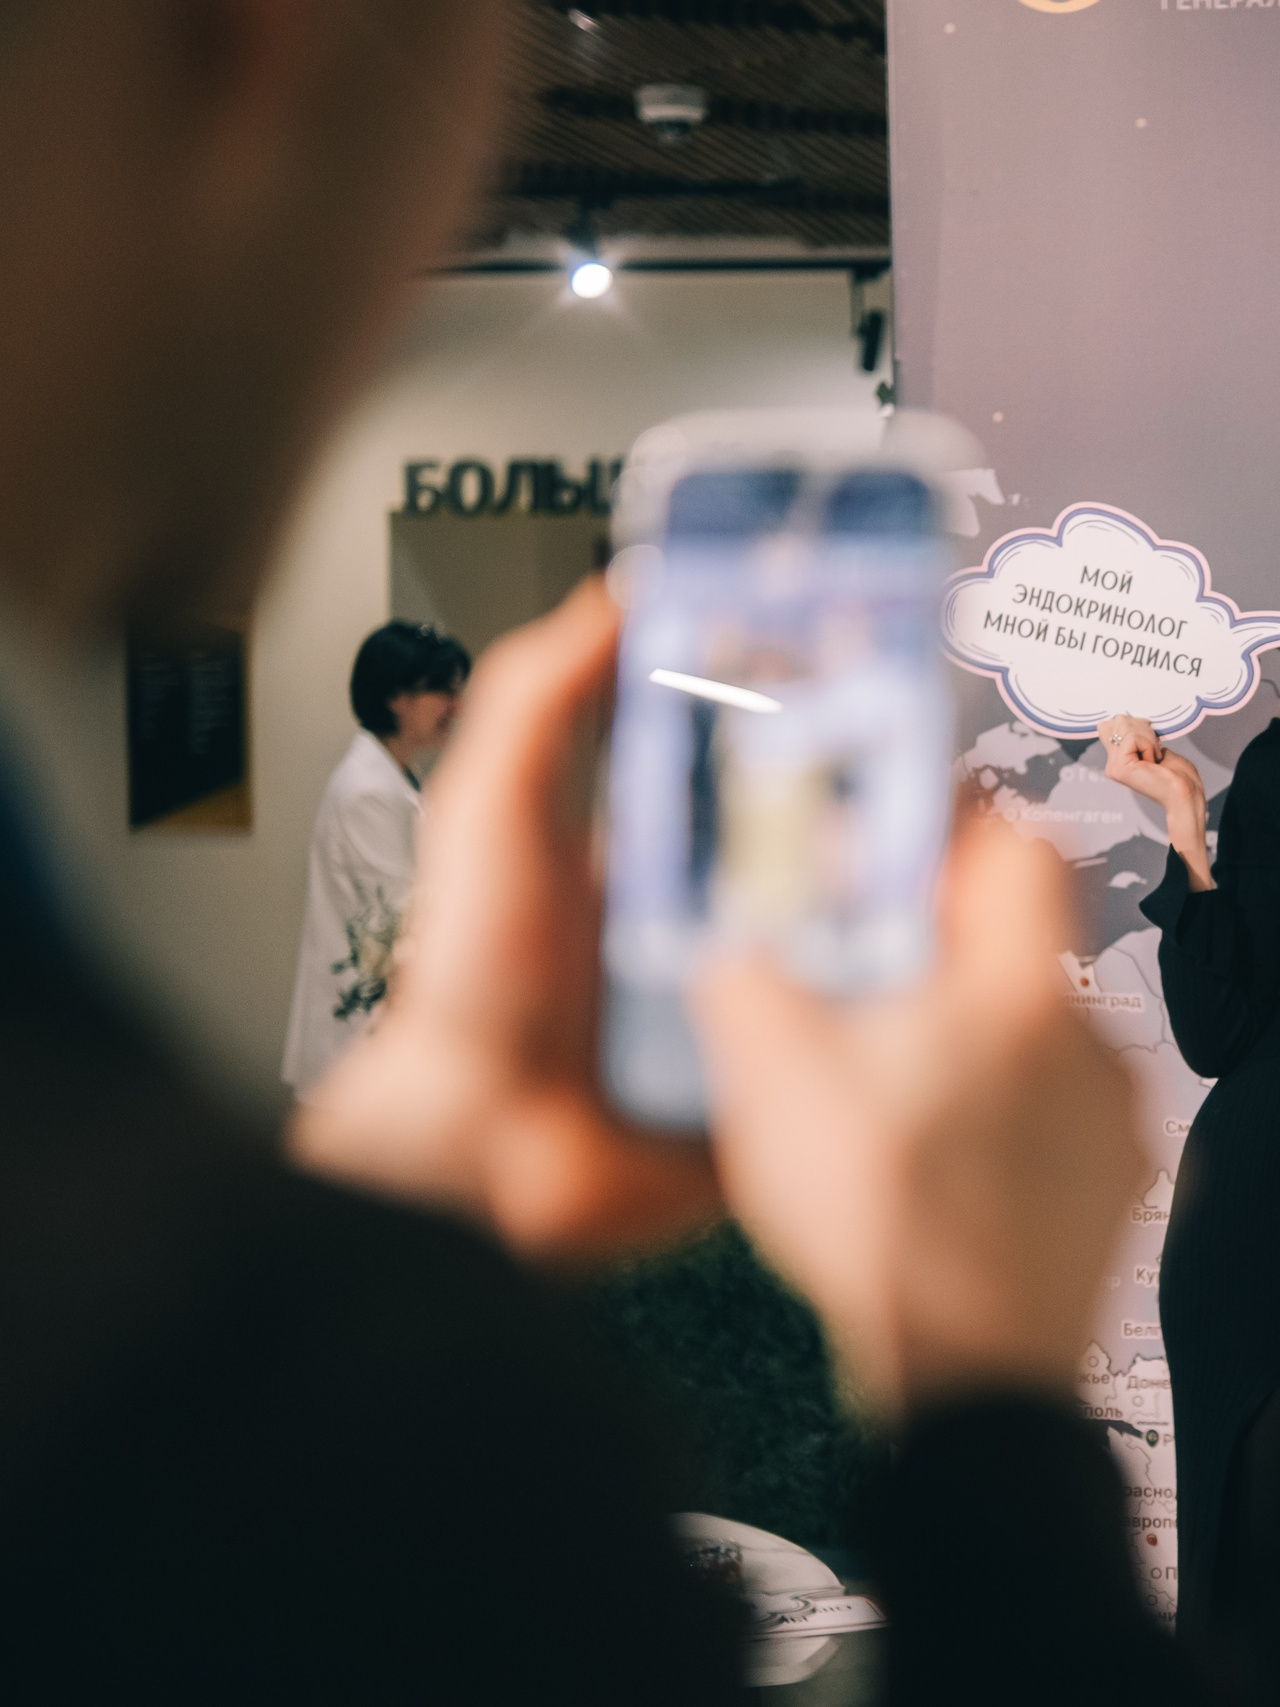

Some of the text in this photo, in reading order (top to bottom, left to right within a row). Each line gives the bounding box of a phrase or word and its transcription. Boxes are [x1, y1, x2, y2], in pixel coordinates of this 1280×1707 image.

[1080, 565, 1133, 595] МОЙ
[1012, 584, 1188, 640] ЭНДОКРИНОЛОГ
[983, 610, 1203, 678] МНОЙ БЫ ГОРДИЛСЯ
[1125, 1486, 1177, 1498] расно
